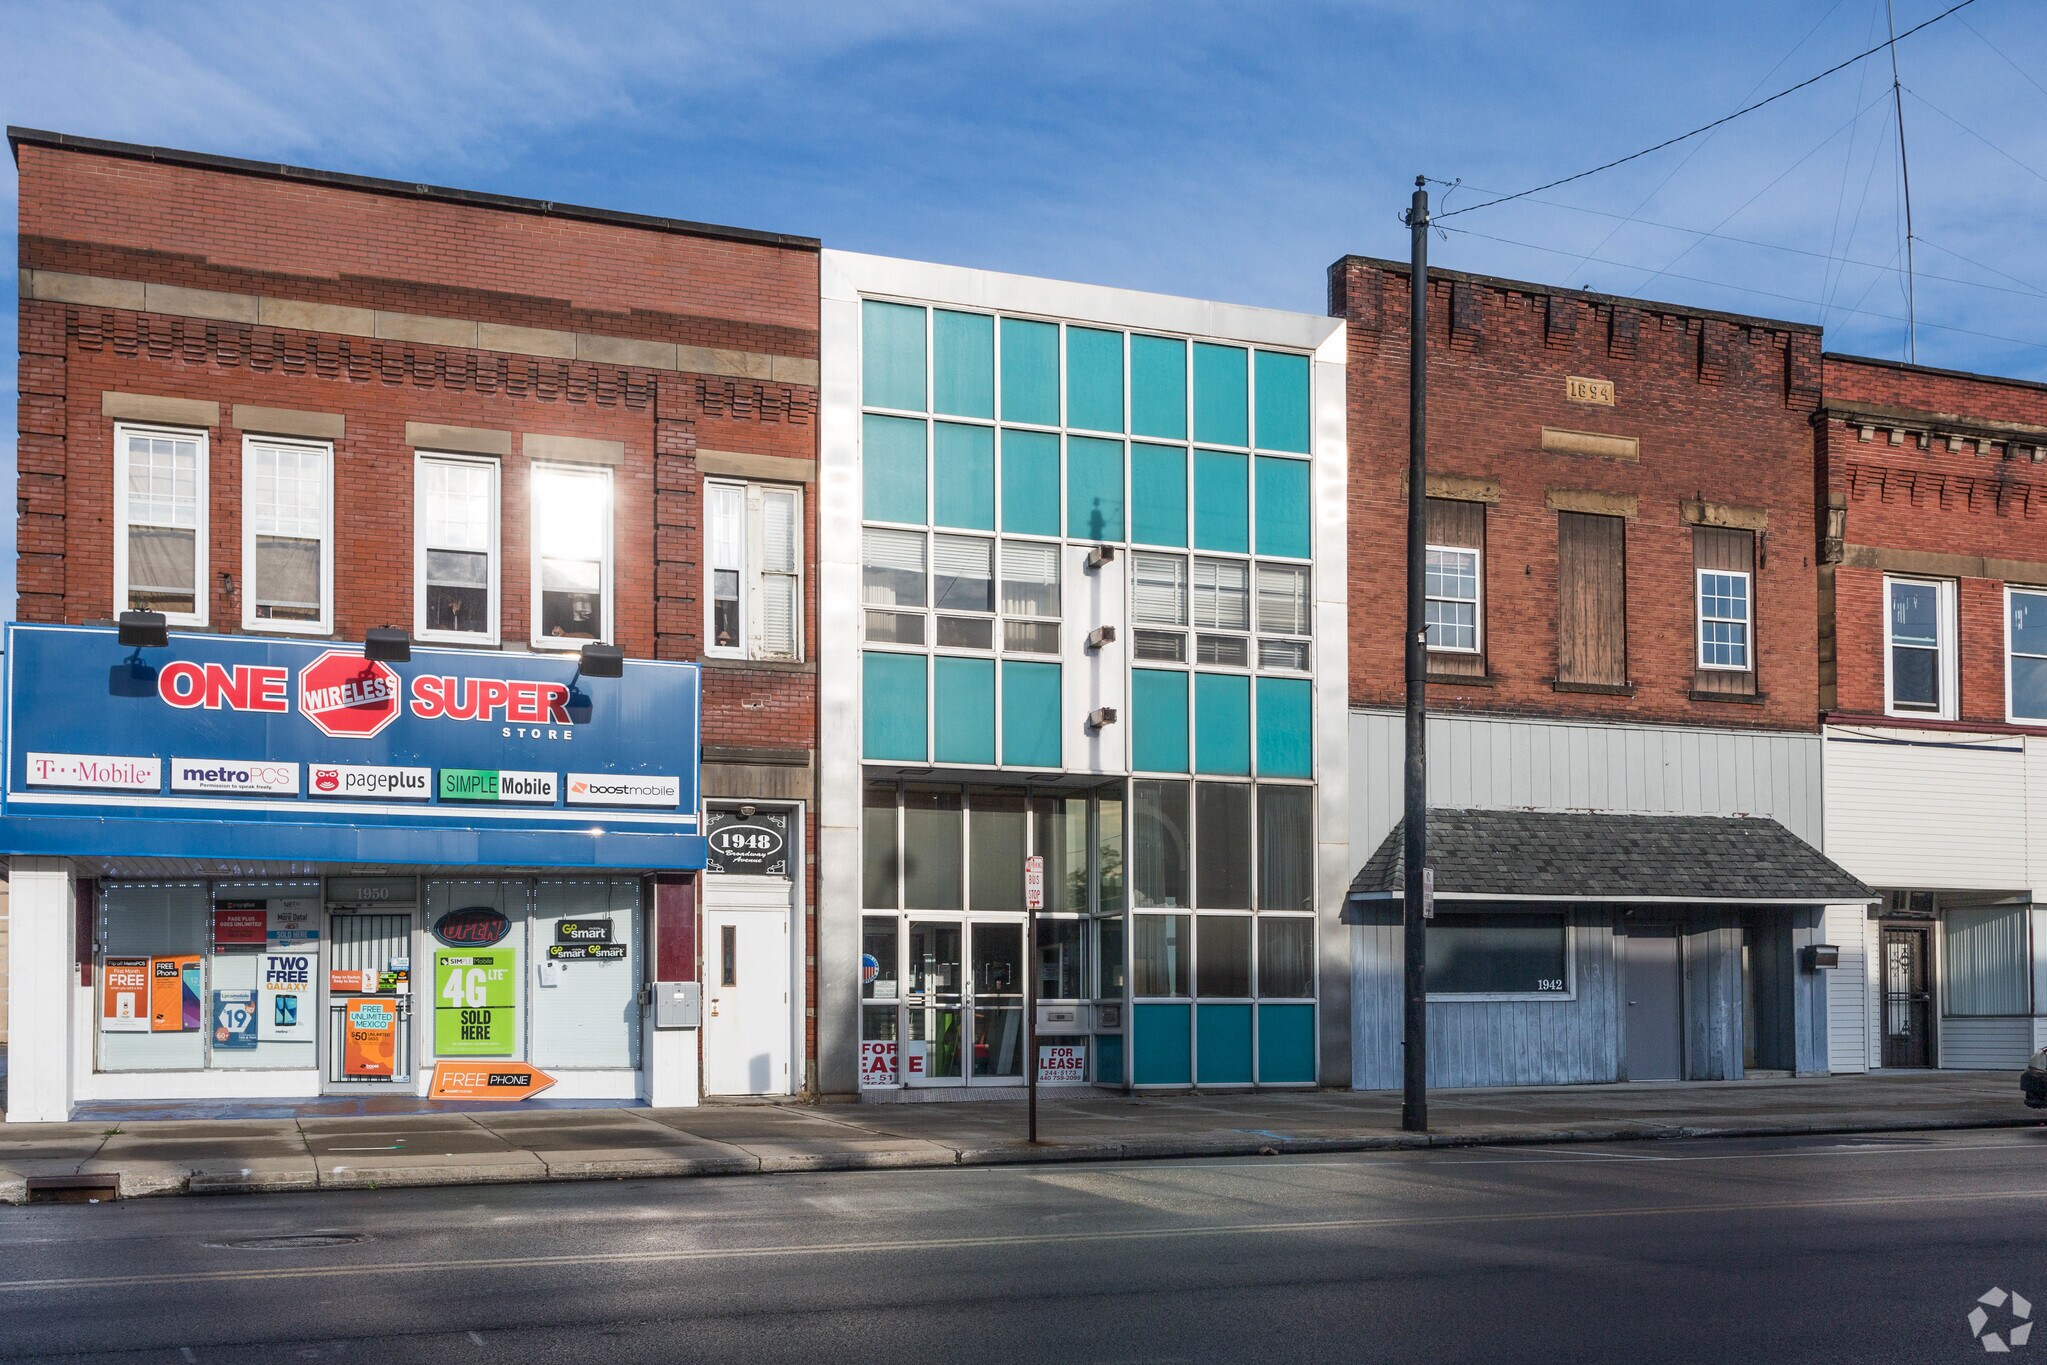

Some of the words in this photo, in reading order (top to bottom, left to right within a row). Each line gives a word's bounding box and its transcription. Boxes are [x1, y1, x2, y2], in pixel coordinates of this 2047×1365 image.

[1570, 382, 1609, 401] 1894
[158, 660, 289, 713] ONE
[304, 676, 397, 711] WIRELESS
[410, 674, 574, 726] SUPER
[502, 727, 573, 740] STORE
[183, 767, 290, 785] metroPCS
[346, 772, 426, 792] pageplus
[446, 775, 498, 793] SIMPLE
[502, 777, 551, 795] Mobile
[590, 783, 675, 796] boostmobile
[721, 833, 771, 849] 1948
[725, 850, 767, 858] Broadway
[1028, 875, 1040, 885] BUS
[357, 887, 389, 900] 1950
[1028, 889, 1041, 900] STOP
[442, 917, 502, 941] OPEN
[562, 924, 577, 934] Go
[571, 928, 606, 938] smart
[550, 946, 563, 955] Go
[557, 949, 586, 958] smart
[588, 945, 601, 954] Go
[595, 948, 624, 957] smart
[156, 962, 174, 970] FREE
[267, 956, 309, 970] TWO
[109, 974, 145, 986] FREE
[266, 970, 308, 982] FREE
[266, 982, 308, 991] GALAXY
[442, 968, 487, 1008] 4G
[1537, 979, 1563, 990] 1942
[460, 1010, 492, 1025] SOLD
[355, 1020, 387, 1028] MEXICO
[351, 1031, 367, 1041] $50
[461, 1025, 491, 1040] HERE
[862, 1043, 898, 1055] FOR
[1051, 1048, 1073, 1057] FOR
[1040, 1057, 1083, 1069] LEASE
[441, 1072, 488, 1087] FREE
[489, 1075, 529, 1085] PHONE
